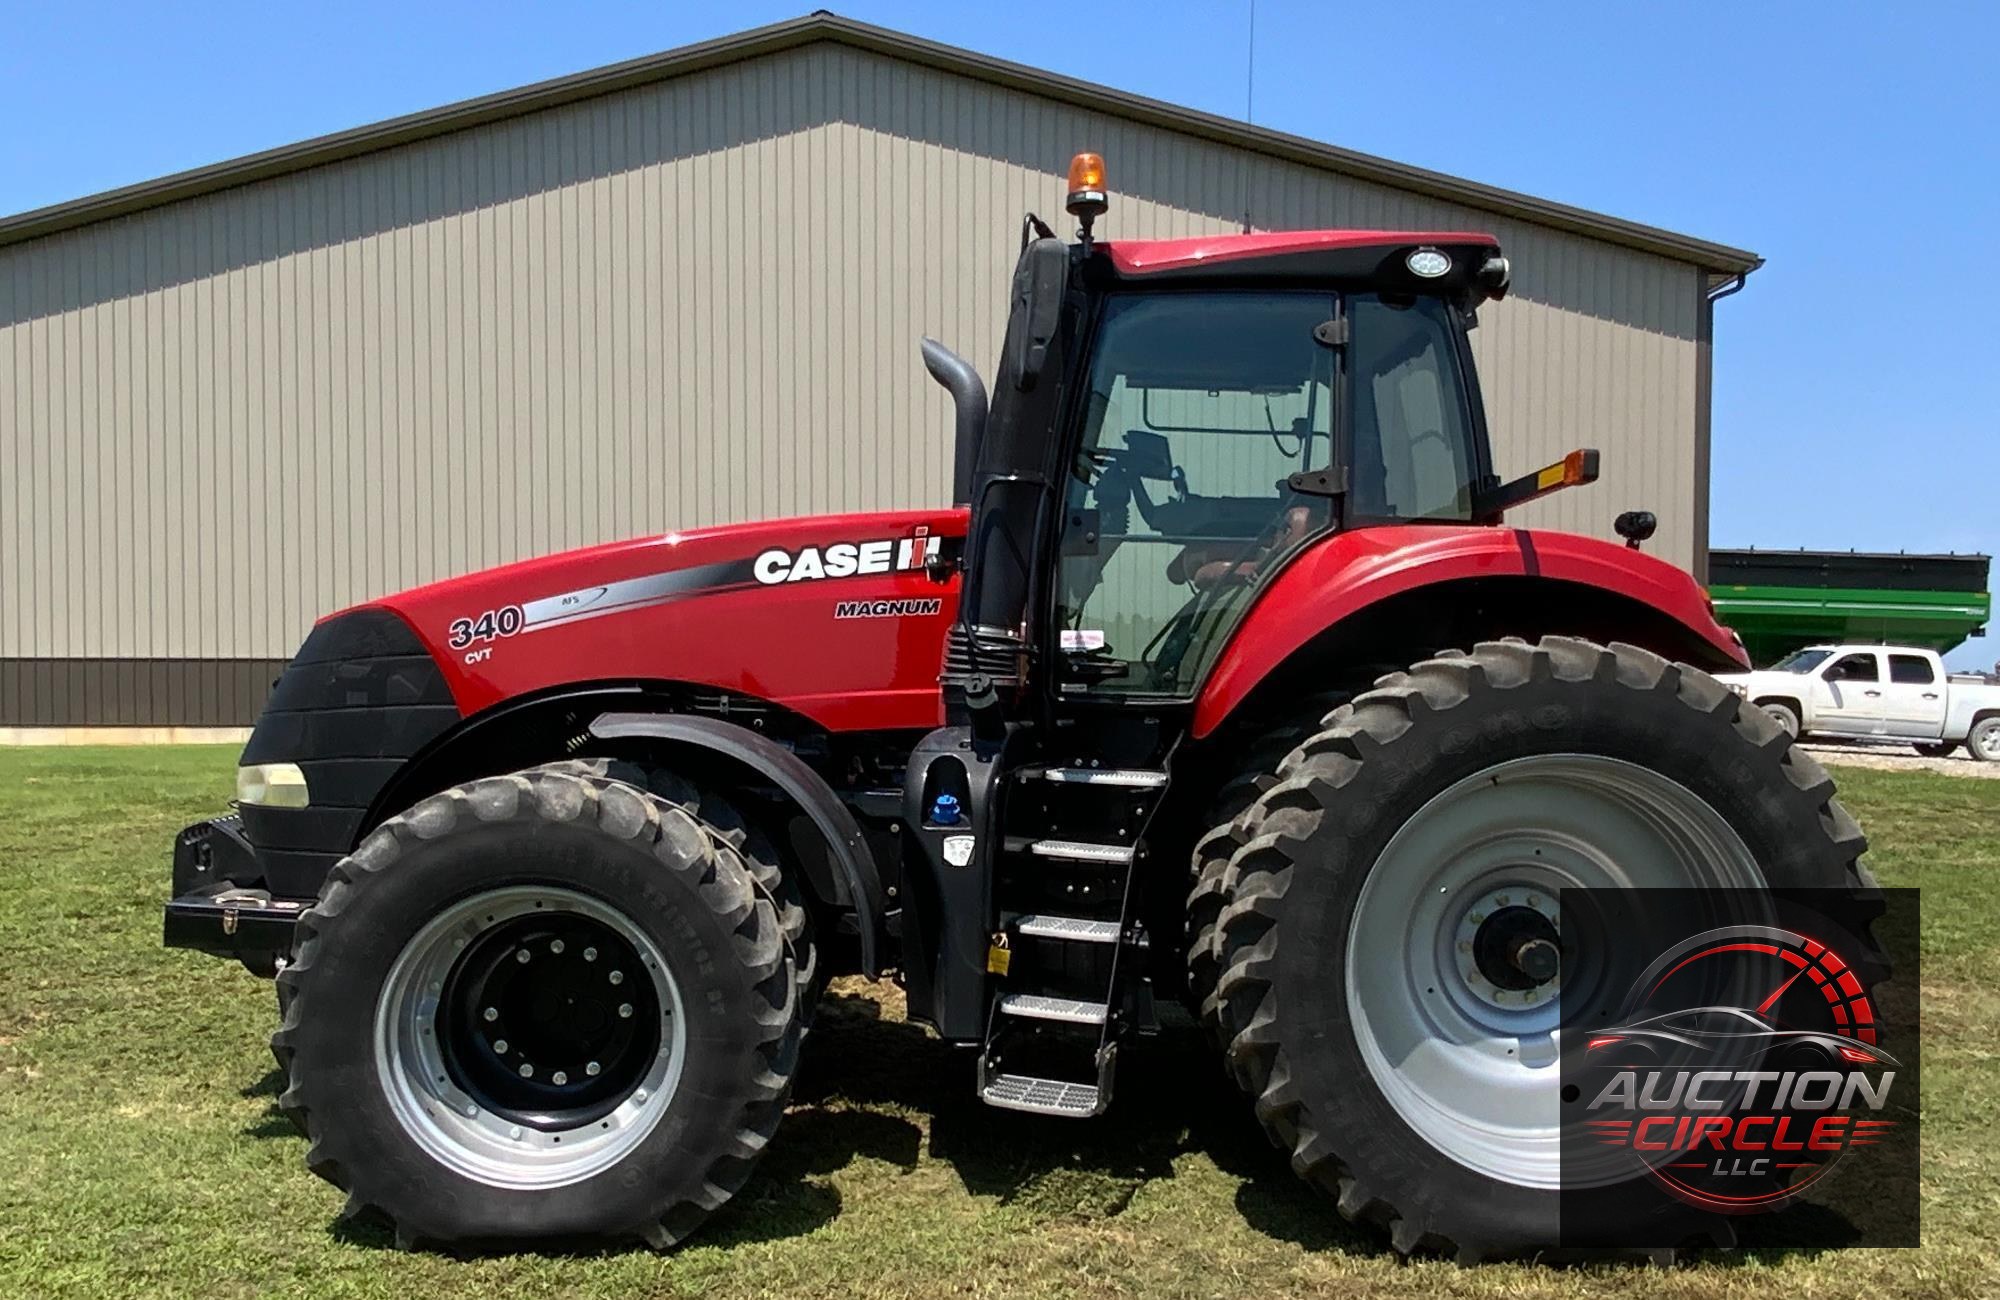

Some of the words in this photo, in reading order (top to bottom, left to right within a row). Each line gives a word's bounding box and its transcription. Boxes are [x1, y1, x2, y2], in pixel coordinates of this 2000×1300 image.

[753, 541, 892, 585] CASE
[834, 598, 942, 619] MAGNUM
[448, 605, 523, 650] 340
[464, 647, 493, 665] CVT
